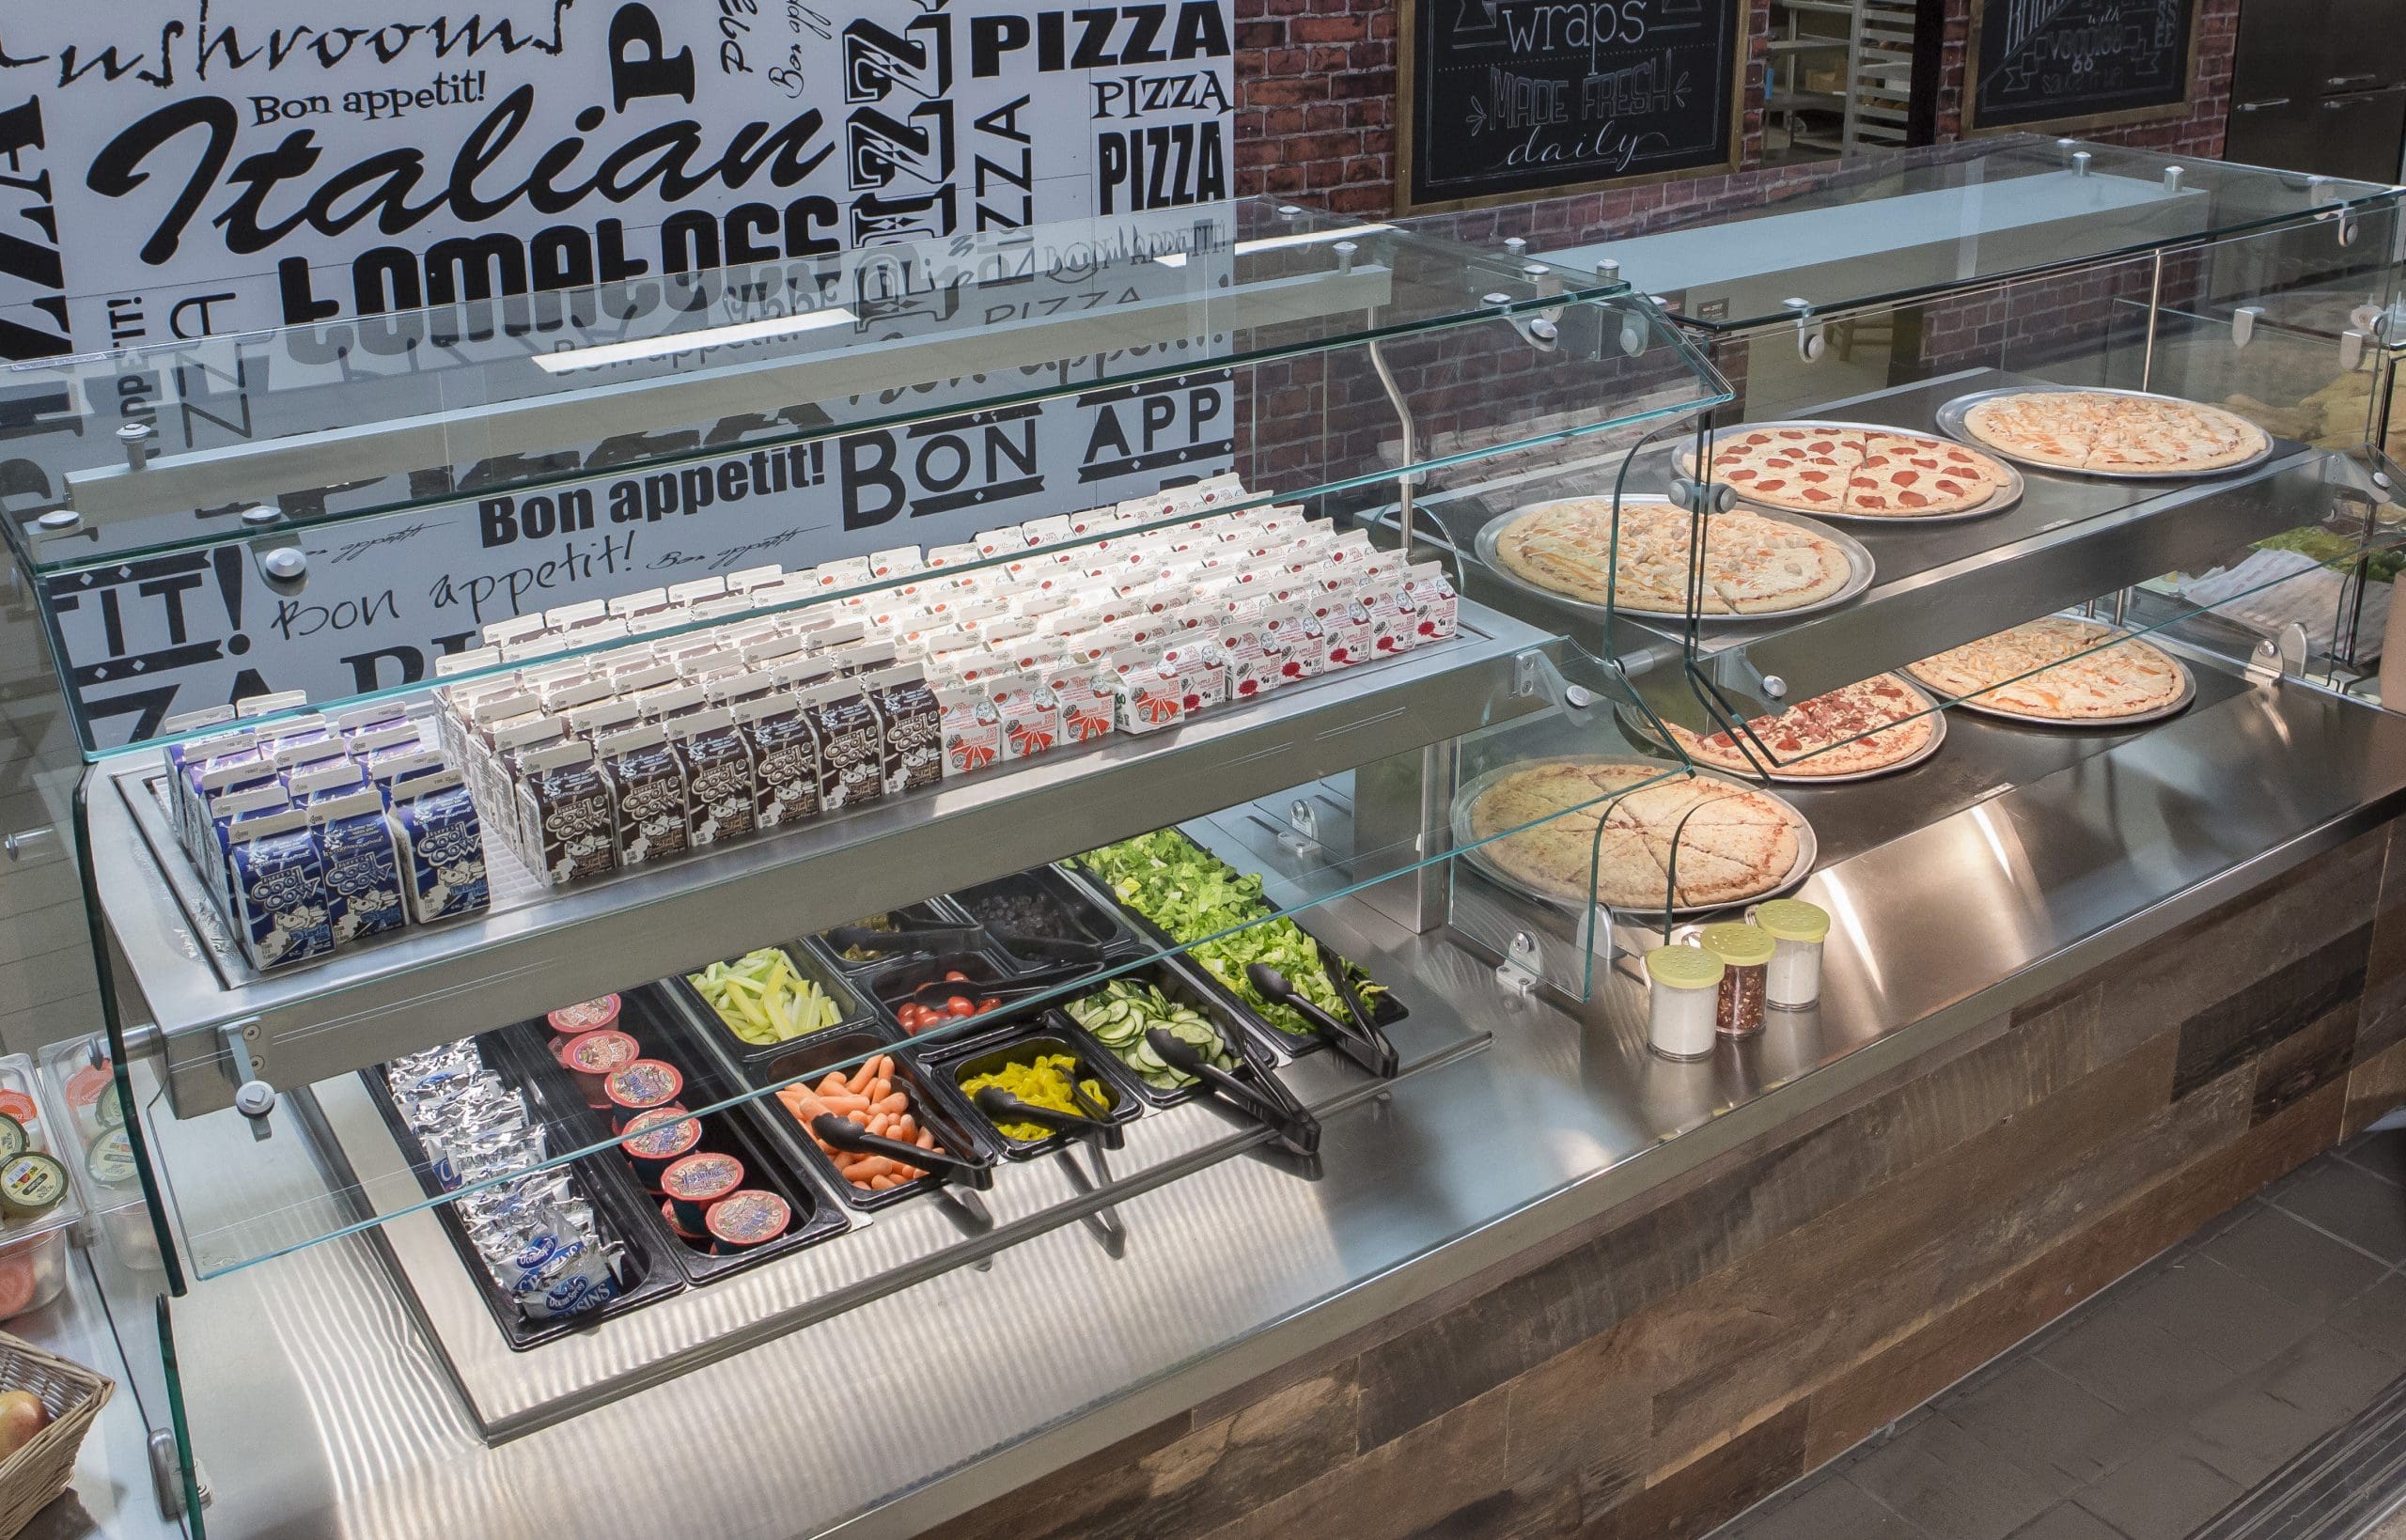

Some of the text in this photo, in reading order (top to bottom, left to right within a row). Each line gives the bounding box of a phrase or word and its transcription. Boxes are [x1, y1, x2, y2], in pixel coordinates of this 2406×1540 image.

[0, 0, 570, 88] ushrooms
[768, 43, 805, 99] Bon
[970, 0, 1231, 78] PIZZA
[1502, 2, 1647, 75] wraps
[246, 70, 486, 126] Bon appetit!
[1091, 70, 1235, 118] PIZZA
[1490, 48, 1672, 130] MADE FRESH
[86, 84, 836, 266] Italian
[1099, 120, 1224, 215] PIZZA
[1500, 120, 1665, 172] daily
[479, 481, 599, 548] Bon
[609, 440, 825, 524] appetit!
[842, 421, 1036, 532] BON
[1084, 385, 1222, 466] APP
[270, 530, 636, 641] Bon appetit!
